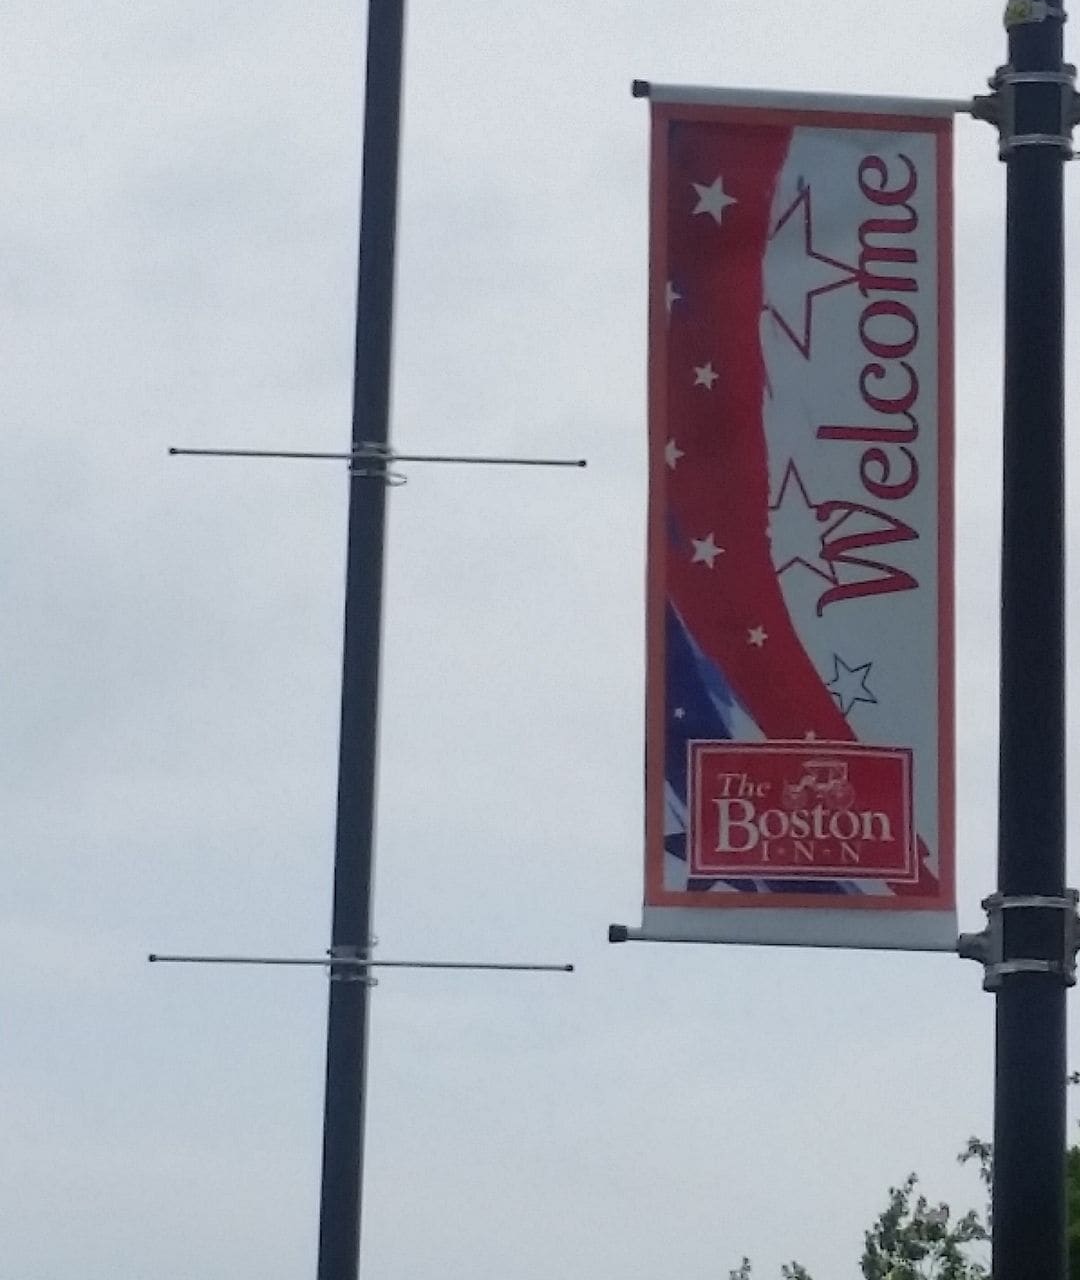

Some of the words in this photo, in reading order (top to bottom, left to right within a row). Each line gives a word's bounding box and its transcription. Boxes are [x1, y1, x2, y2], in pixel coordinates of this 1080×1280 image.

[815, 153, 920, 617] Welcome
[717, 772, 771, 798] The
[712, 798, 896, 853] Boston
